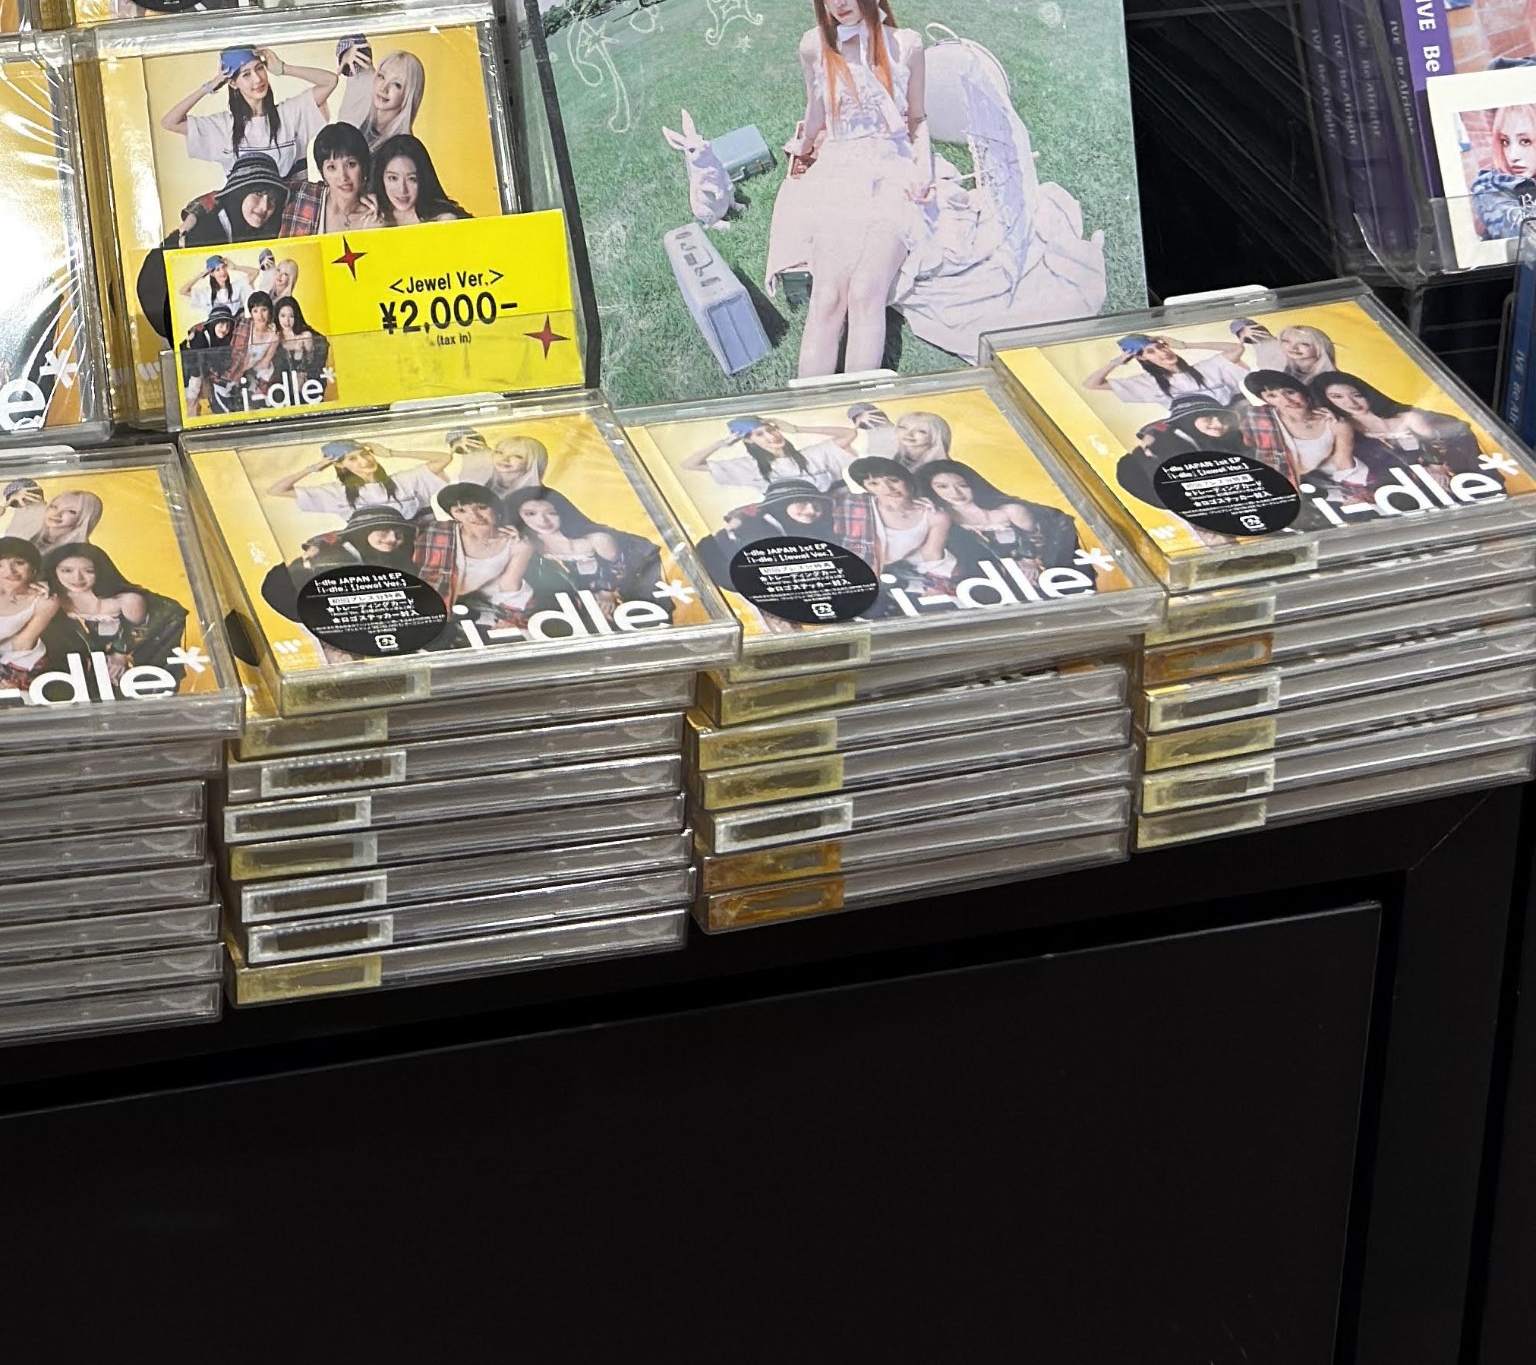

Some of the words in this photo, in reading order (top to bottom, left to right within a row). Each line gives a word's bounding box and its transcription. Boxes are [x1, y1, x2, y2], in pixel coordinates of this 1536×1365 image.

[1422, 45, 1440, 72] Be
[436, 334, 456, 347] (tax
[458, 332, 472, 345] in)
